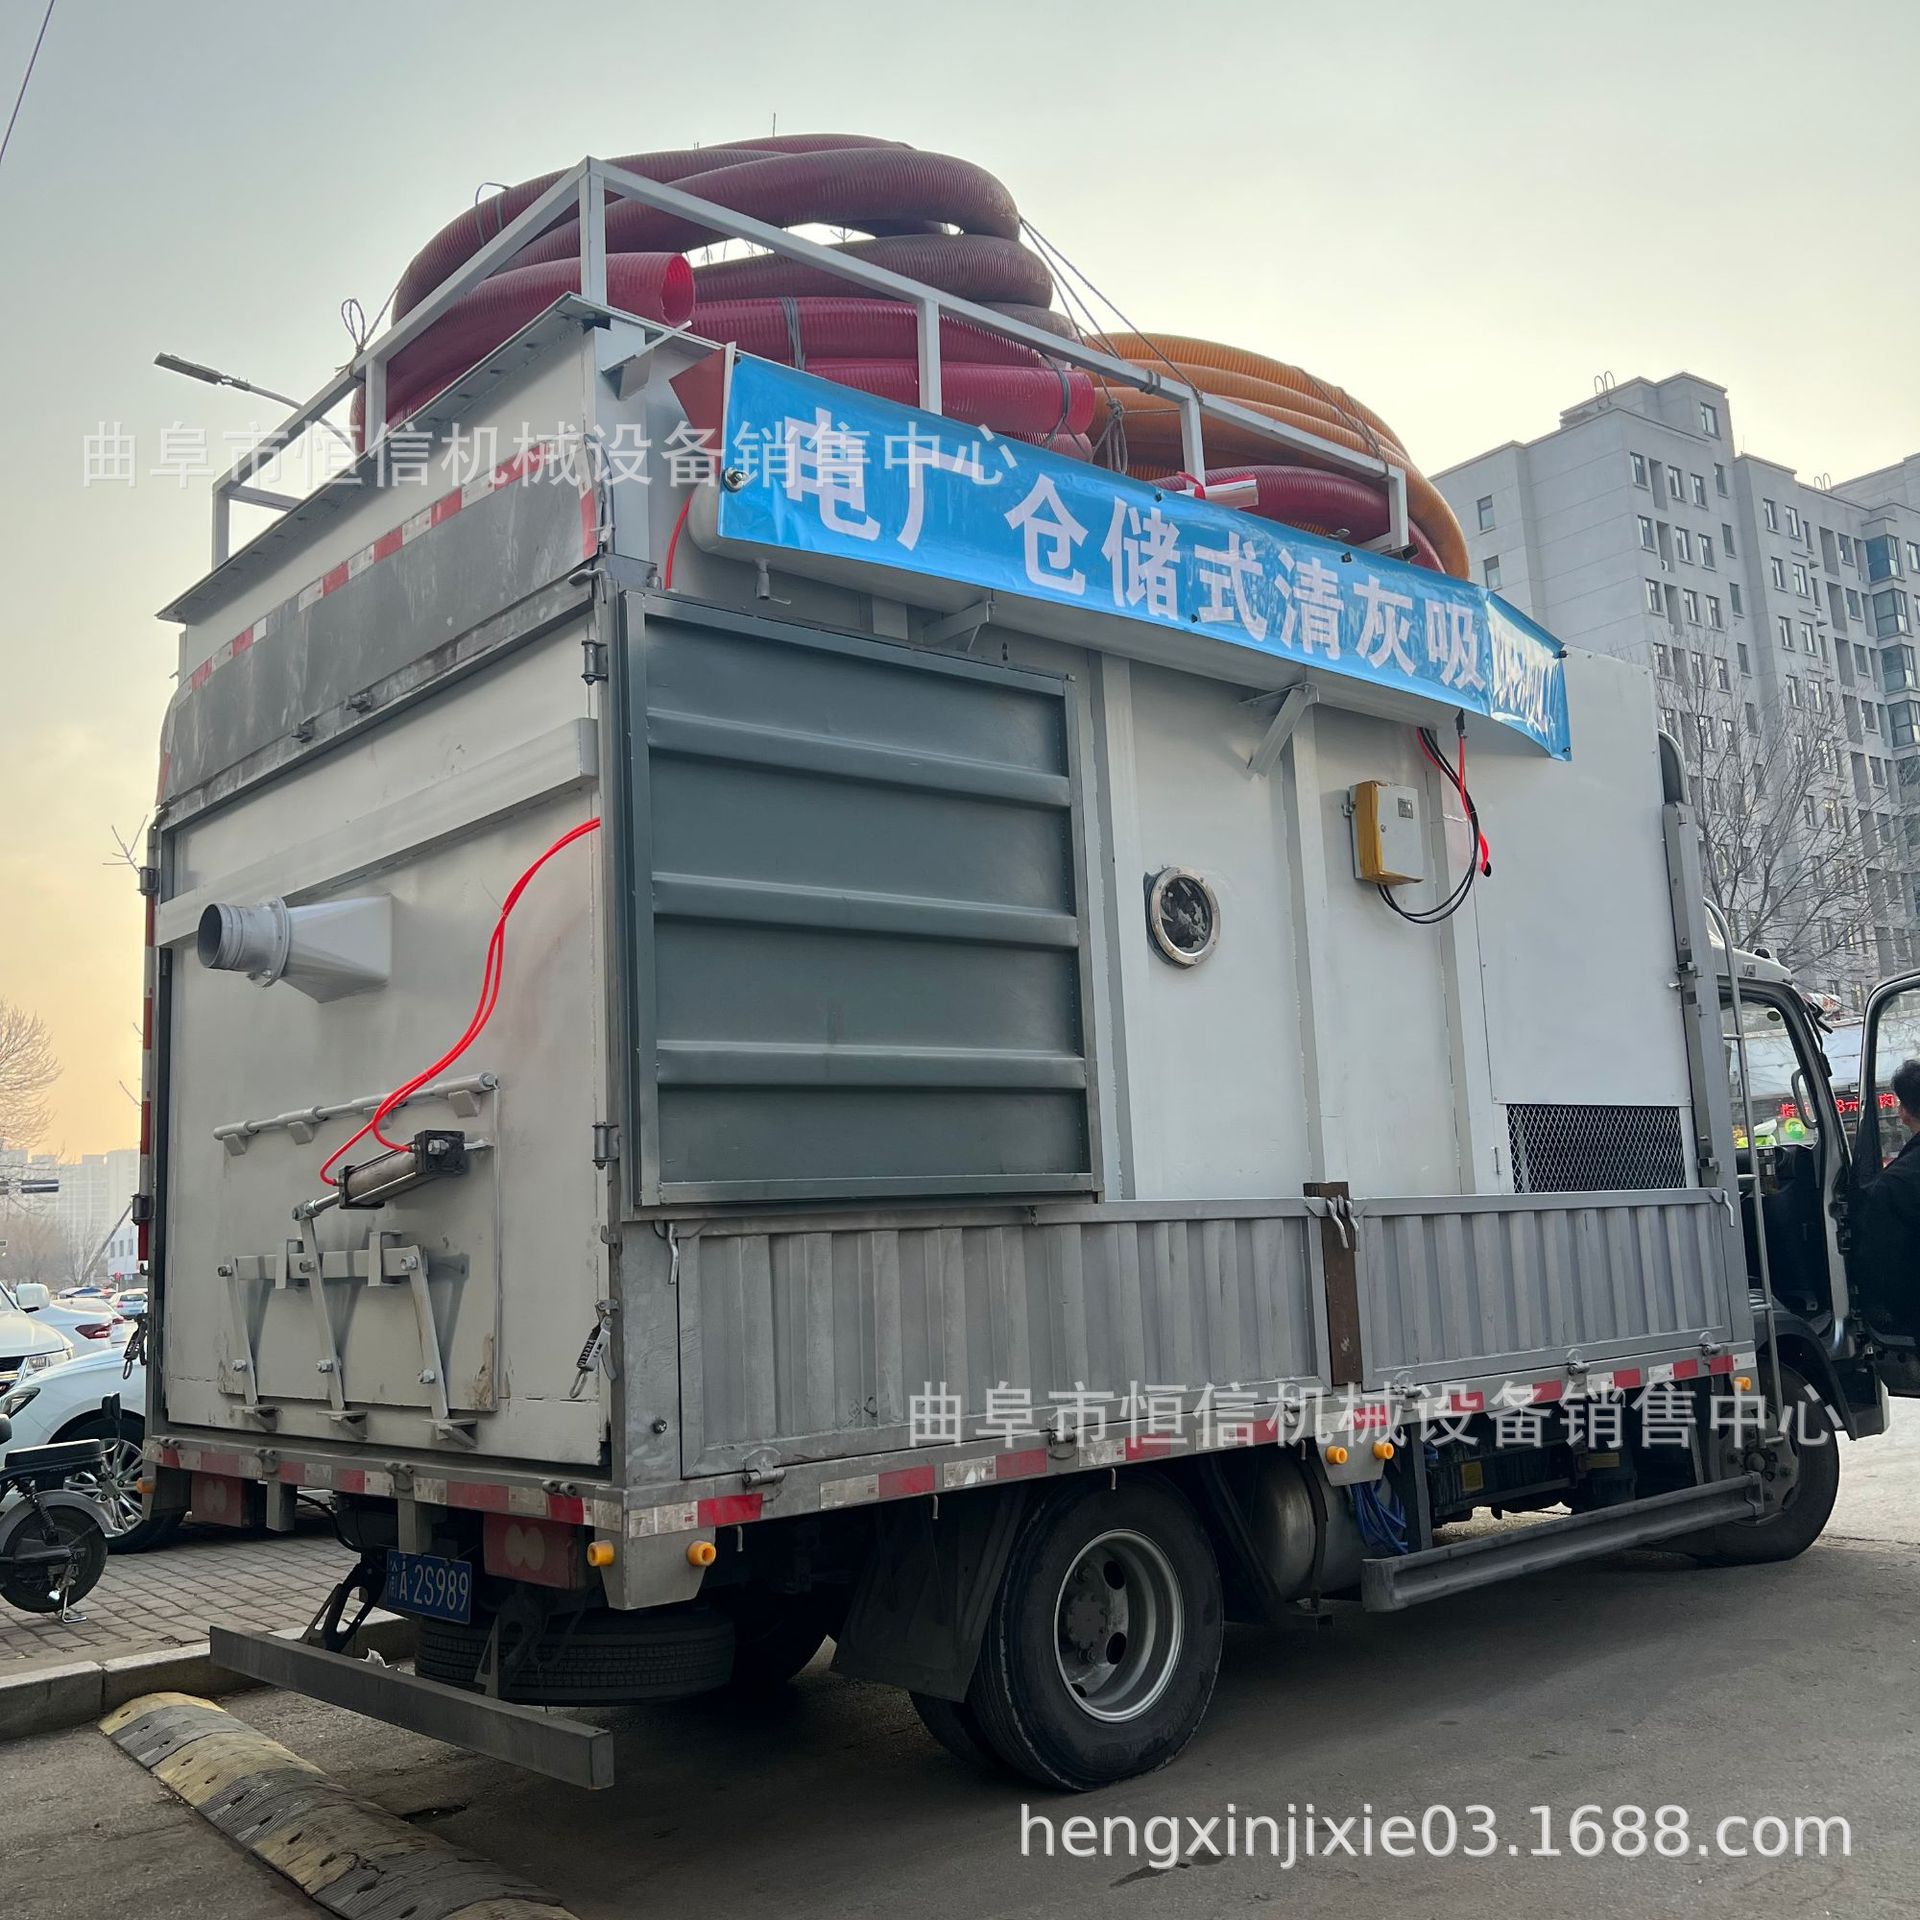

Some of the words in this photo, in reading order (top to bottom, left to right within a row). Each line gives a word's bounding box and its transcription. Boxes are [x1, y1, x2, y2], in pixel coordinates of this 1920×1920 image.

[784, 406, 1553, 733] 电厂仓储式清灰吸
